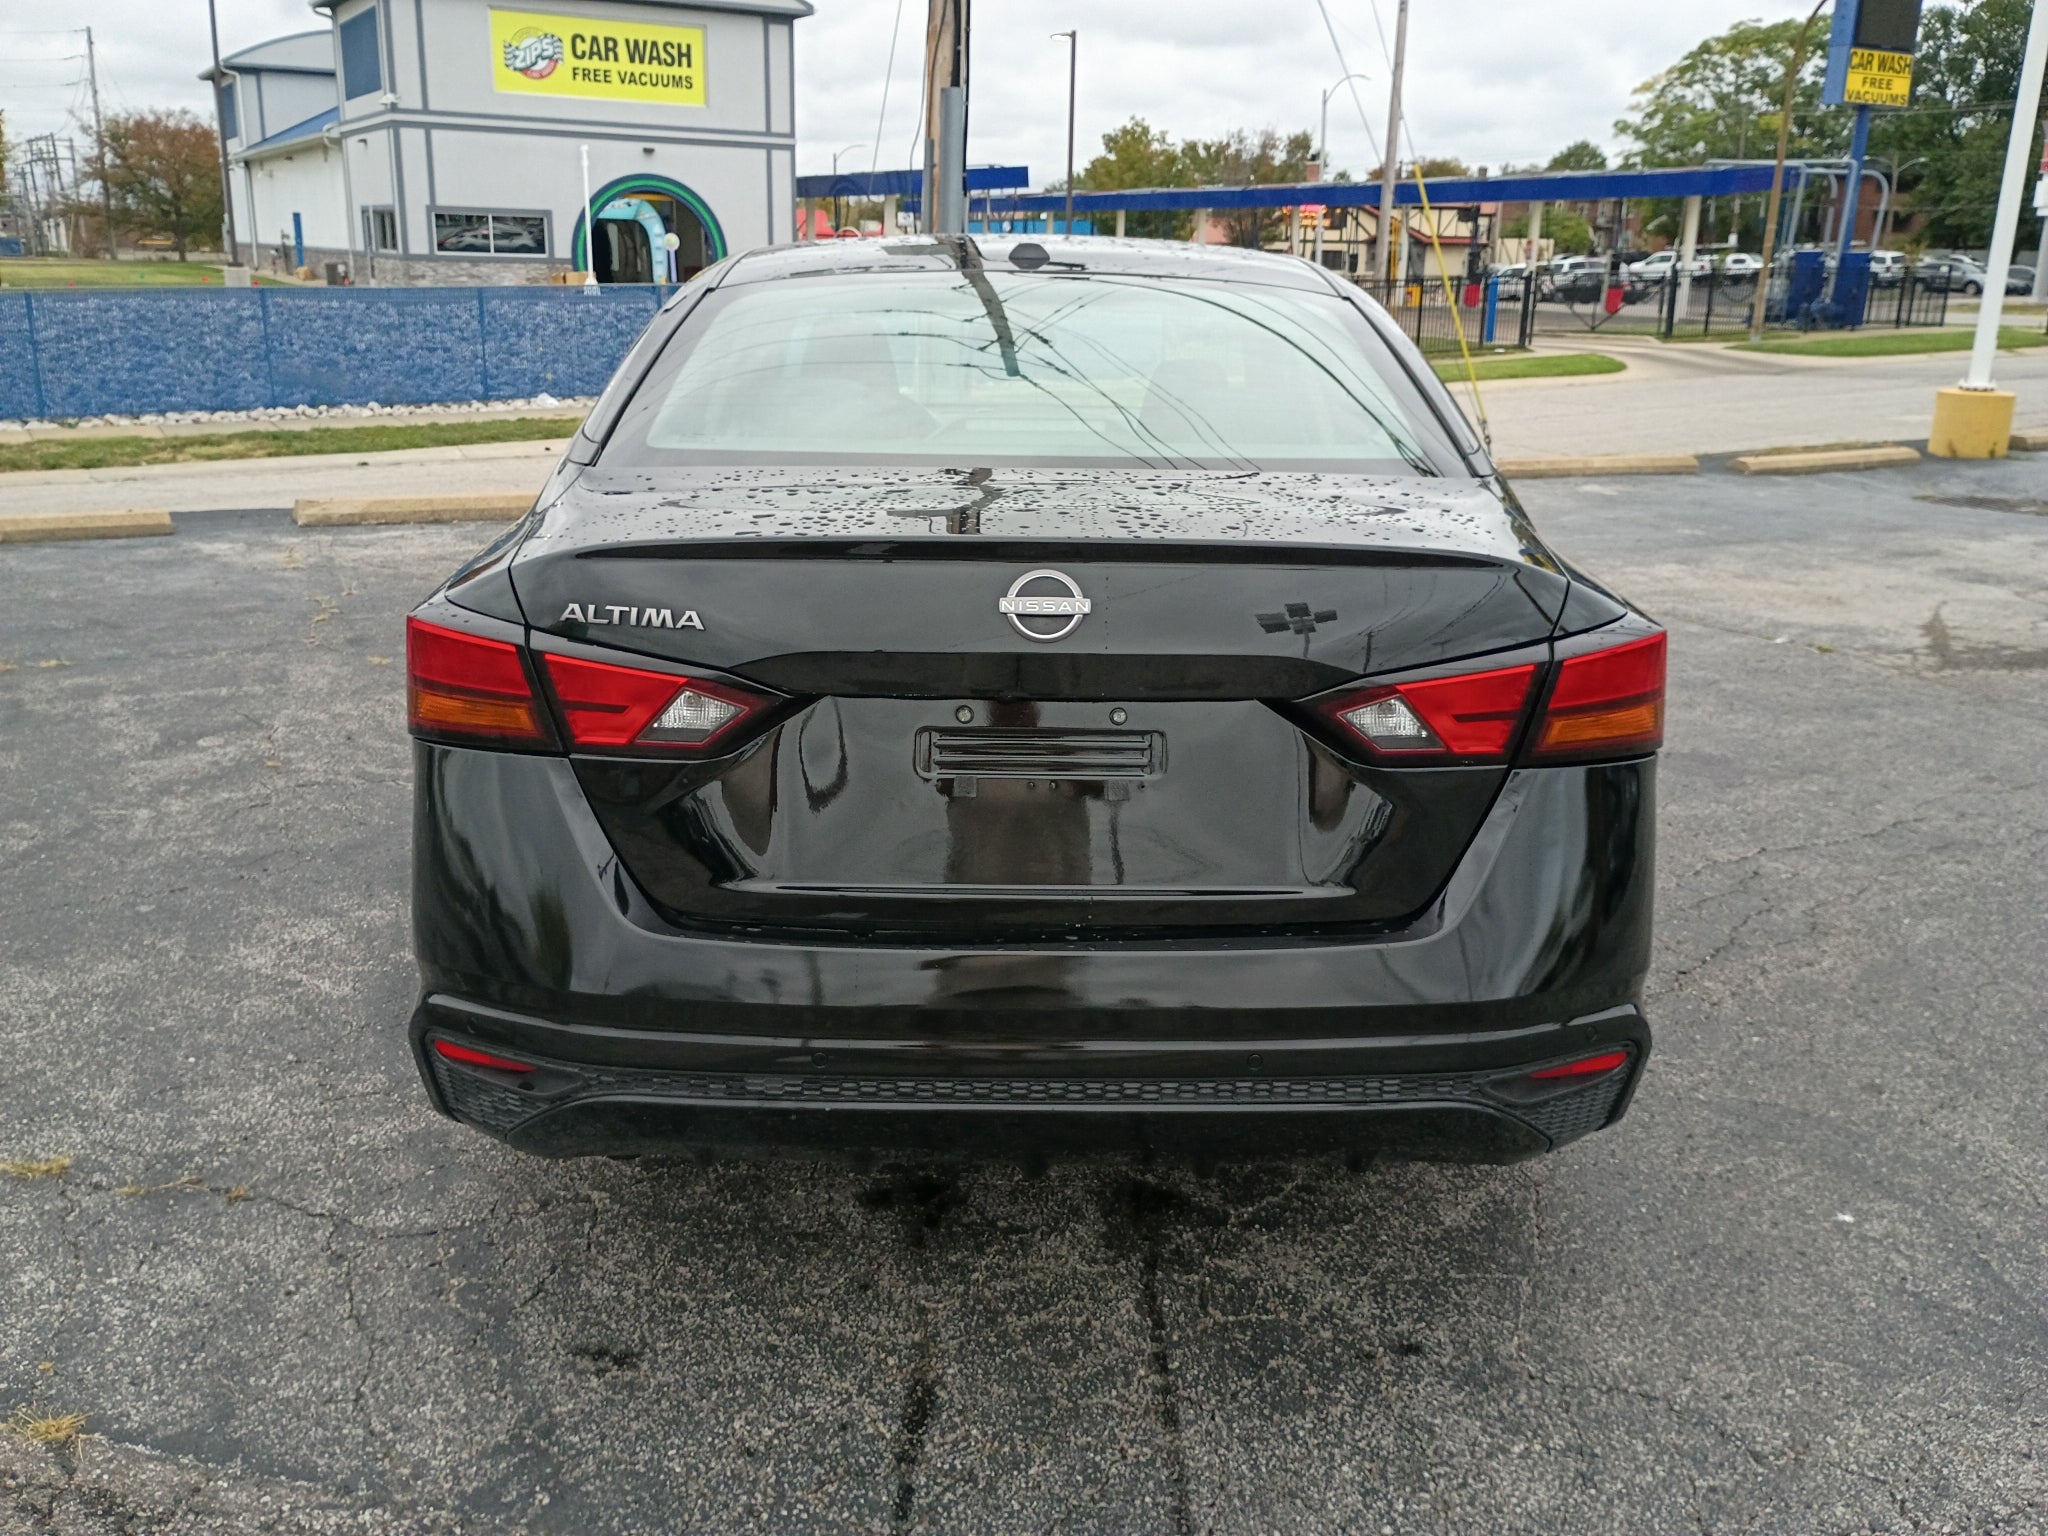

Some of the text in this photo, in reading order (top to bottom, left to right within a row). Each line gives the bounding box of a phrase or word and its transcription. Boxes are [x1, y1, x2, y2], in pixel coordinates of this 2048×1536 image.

[512, 37, 555, 69] ZIPS
[571, 33, 692, 68] CAR WASH
[1849, 51, 1912, 75] CAR WASH
[572, 67, 612, 84] FREE
[617, 71, 694, 90] VACUUMS
[1861, 77, 1893, 91] FREE
[1846, 90, 1908, 106] VACUUMS
[559, 603, 705, 631] ALTIMA
[1001, 600, 1089, 612] NISSAN
